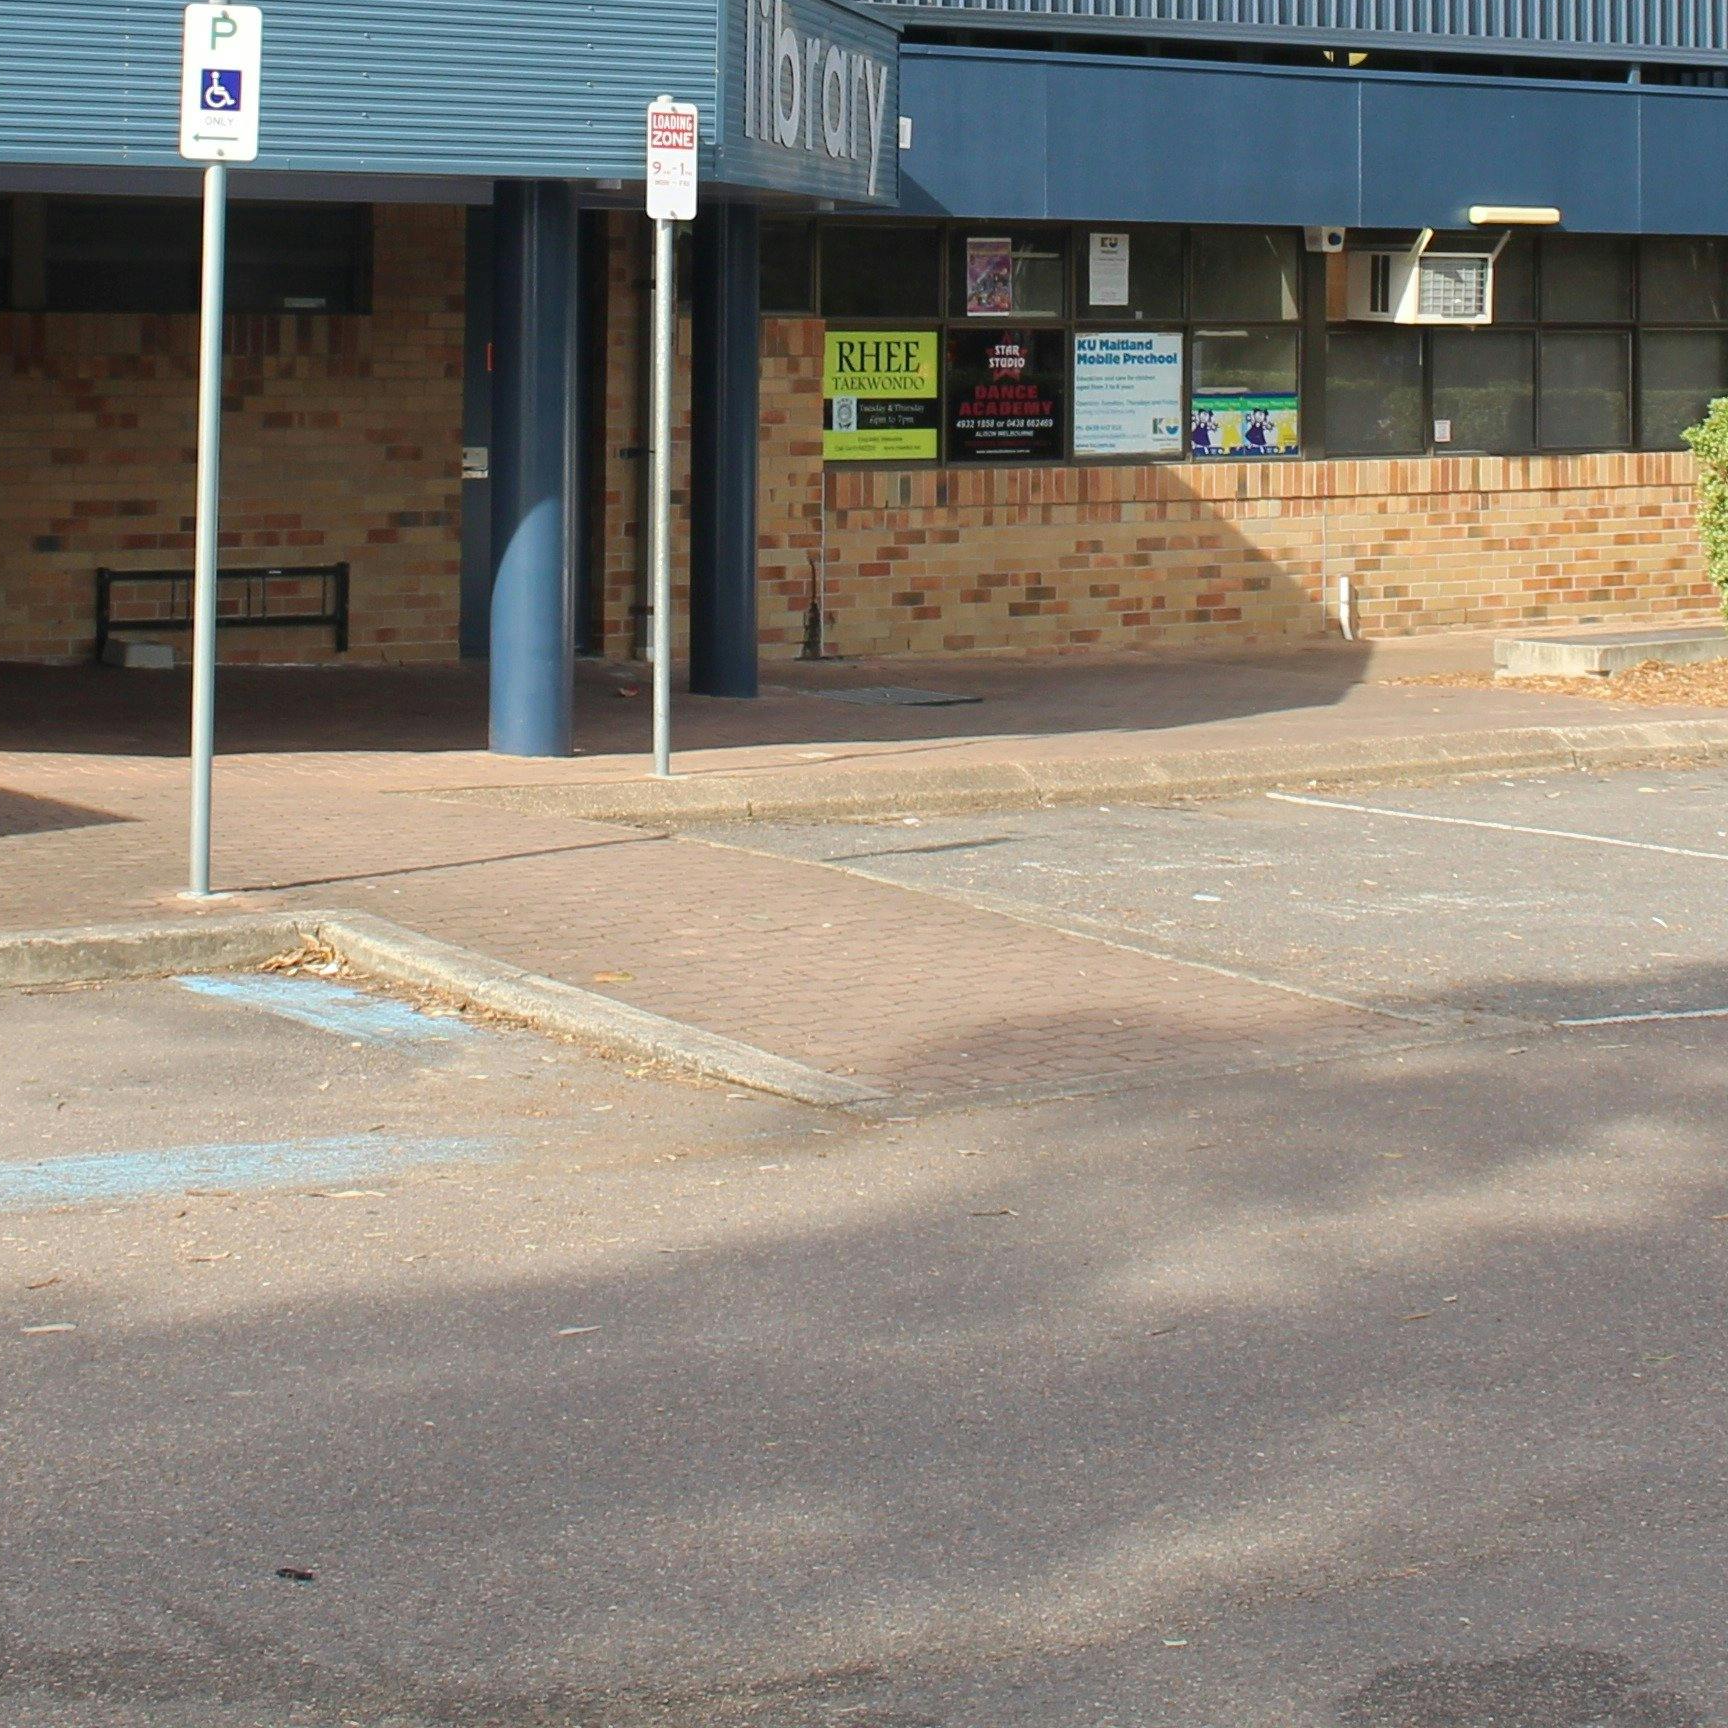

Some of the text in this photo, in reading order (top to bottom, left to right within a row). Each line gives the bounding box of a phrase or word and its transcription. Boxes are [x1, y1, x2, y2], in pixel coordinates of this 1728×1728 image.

[210, 16, 238, 50] P
[203, 115, 235, 127] ONLY
[653, 114, 693, 131] LOADING
[652, 131, 693, 147] ZONE
[994, 344, 1021, 357] STAR
[1076, 338, 1153, 351] KU Maitland
[836, 341, 920, 373] RHEE
[988, 357, 1026, 369] STUDIO
[1076, 353, 1120, 365] Mobile
[832, 376, 925, 391] TAEKWONDO
[974, 384, 1038, 399] DANCE
[860, 403, 886, 412] Tuesday
[895, 403, 925, 413] Thursday
[959, 400, 1053, 416] ACADEMY
[996, 420, 1006, 428] or
